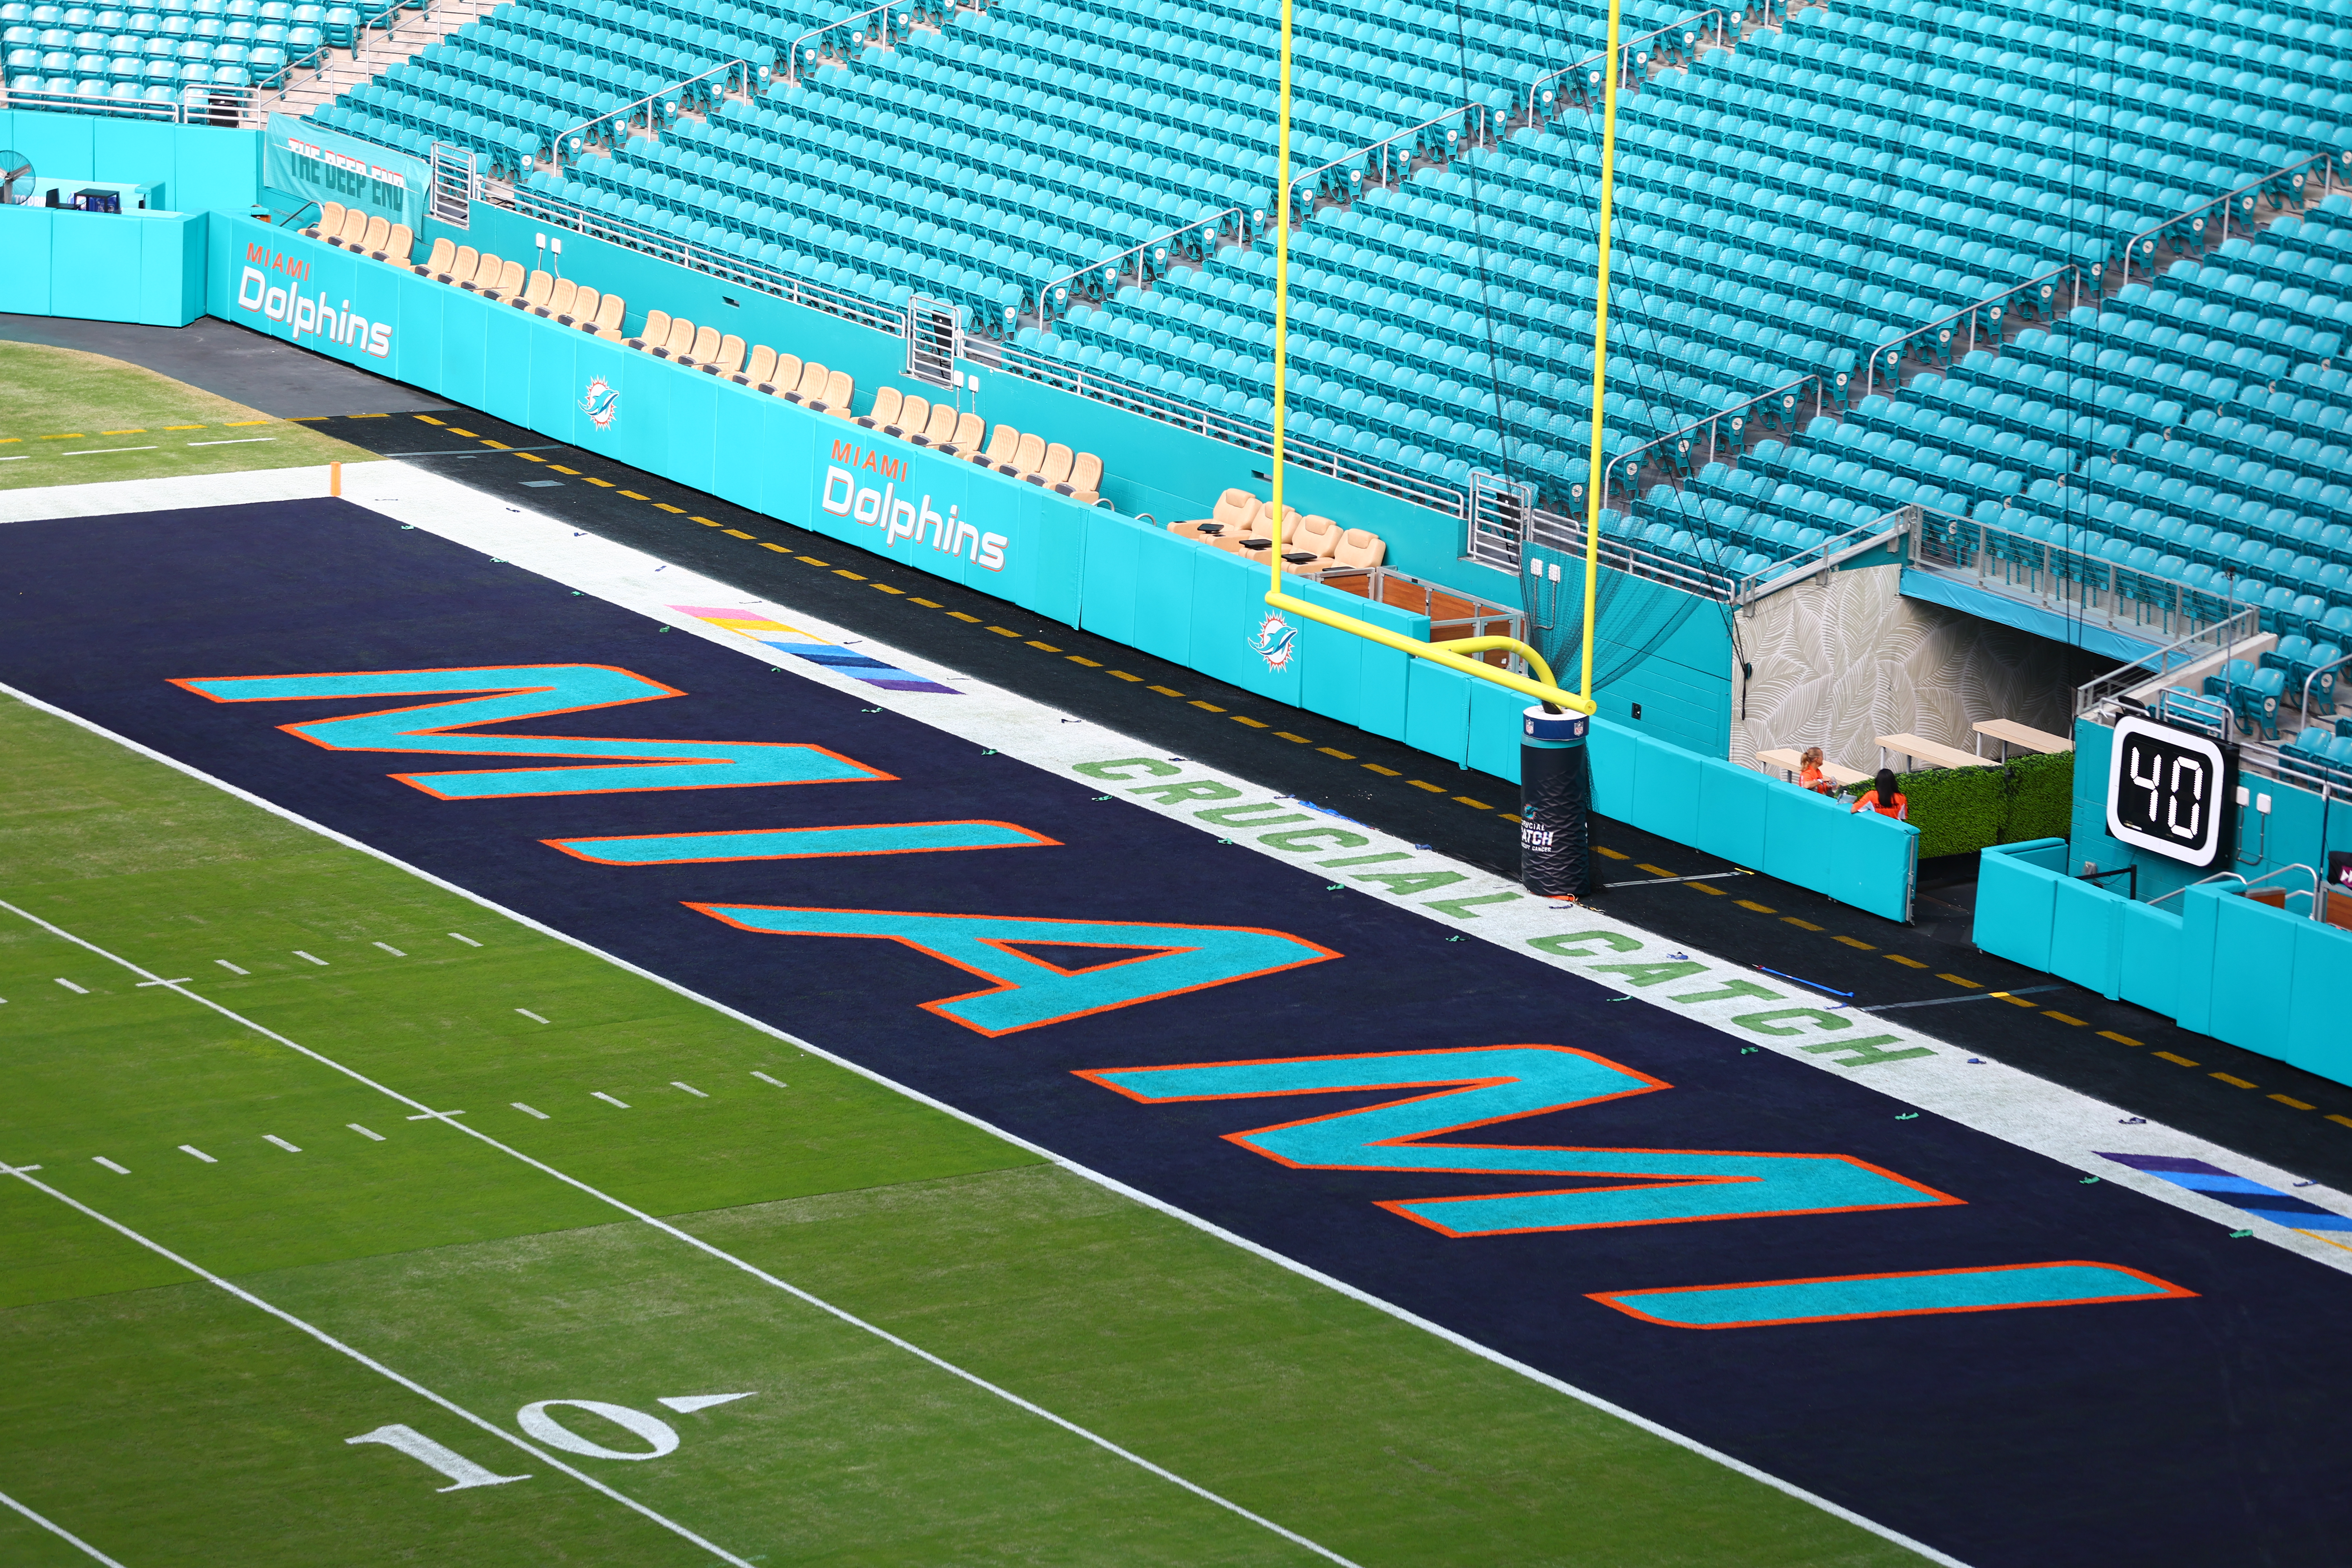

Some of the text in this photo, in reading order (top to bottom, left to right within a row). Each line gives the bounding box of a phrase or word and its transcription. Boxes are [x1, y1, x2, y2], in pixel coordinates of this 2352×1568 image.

[289, 138, 404, 212] THE DEEP END
[247, 242, 310, 281] MIAMI
[238, 265, 392, 358] Dolphins
[831, 439, 907, 482] MIAMI
[822, 465, 1009, 572] Dolphins
[2130, 746, 2203, 840] 40
[1073, 757, 1935, 1067] CRUCIAL CATCH
[166, 662, 2201, 1330] MIAMI
[344, 1399, 681, 1494] 10
